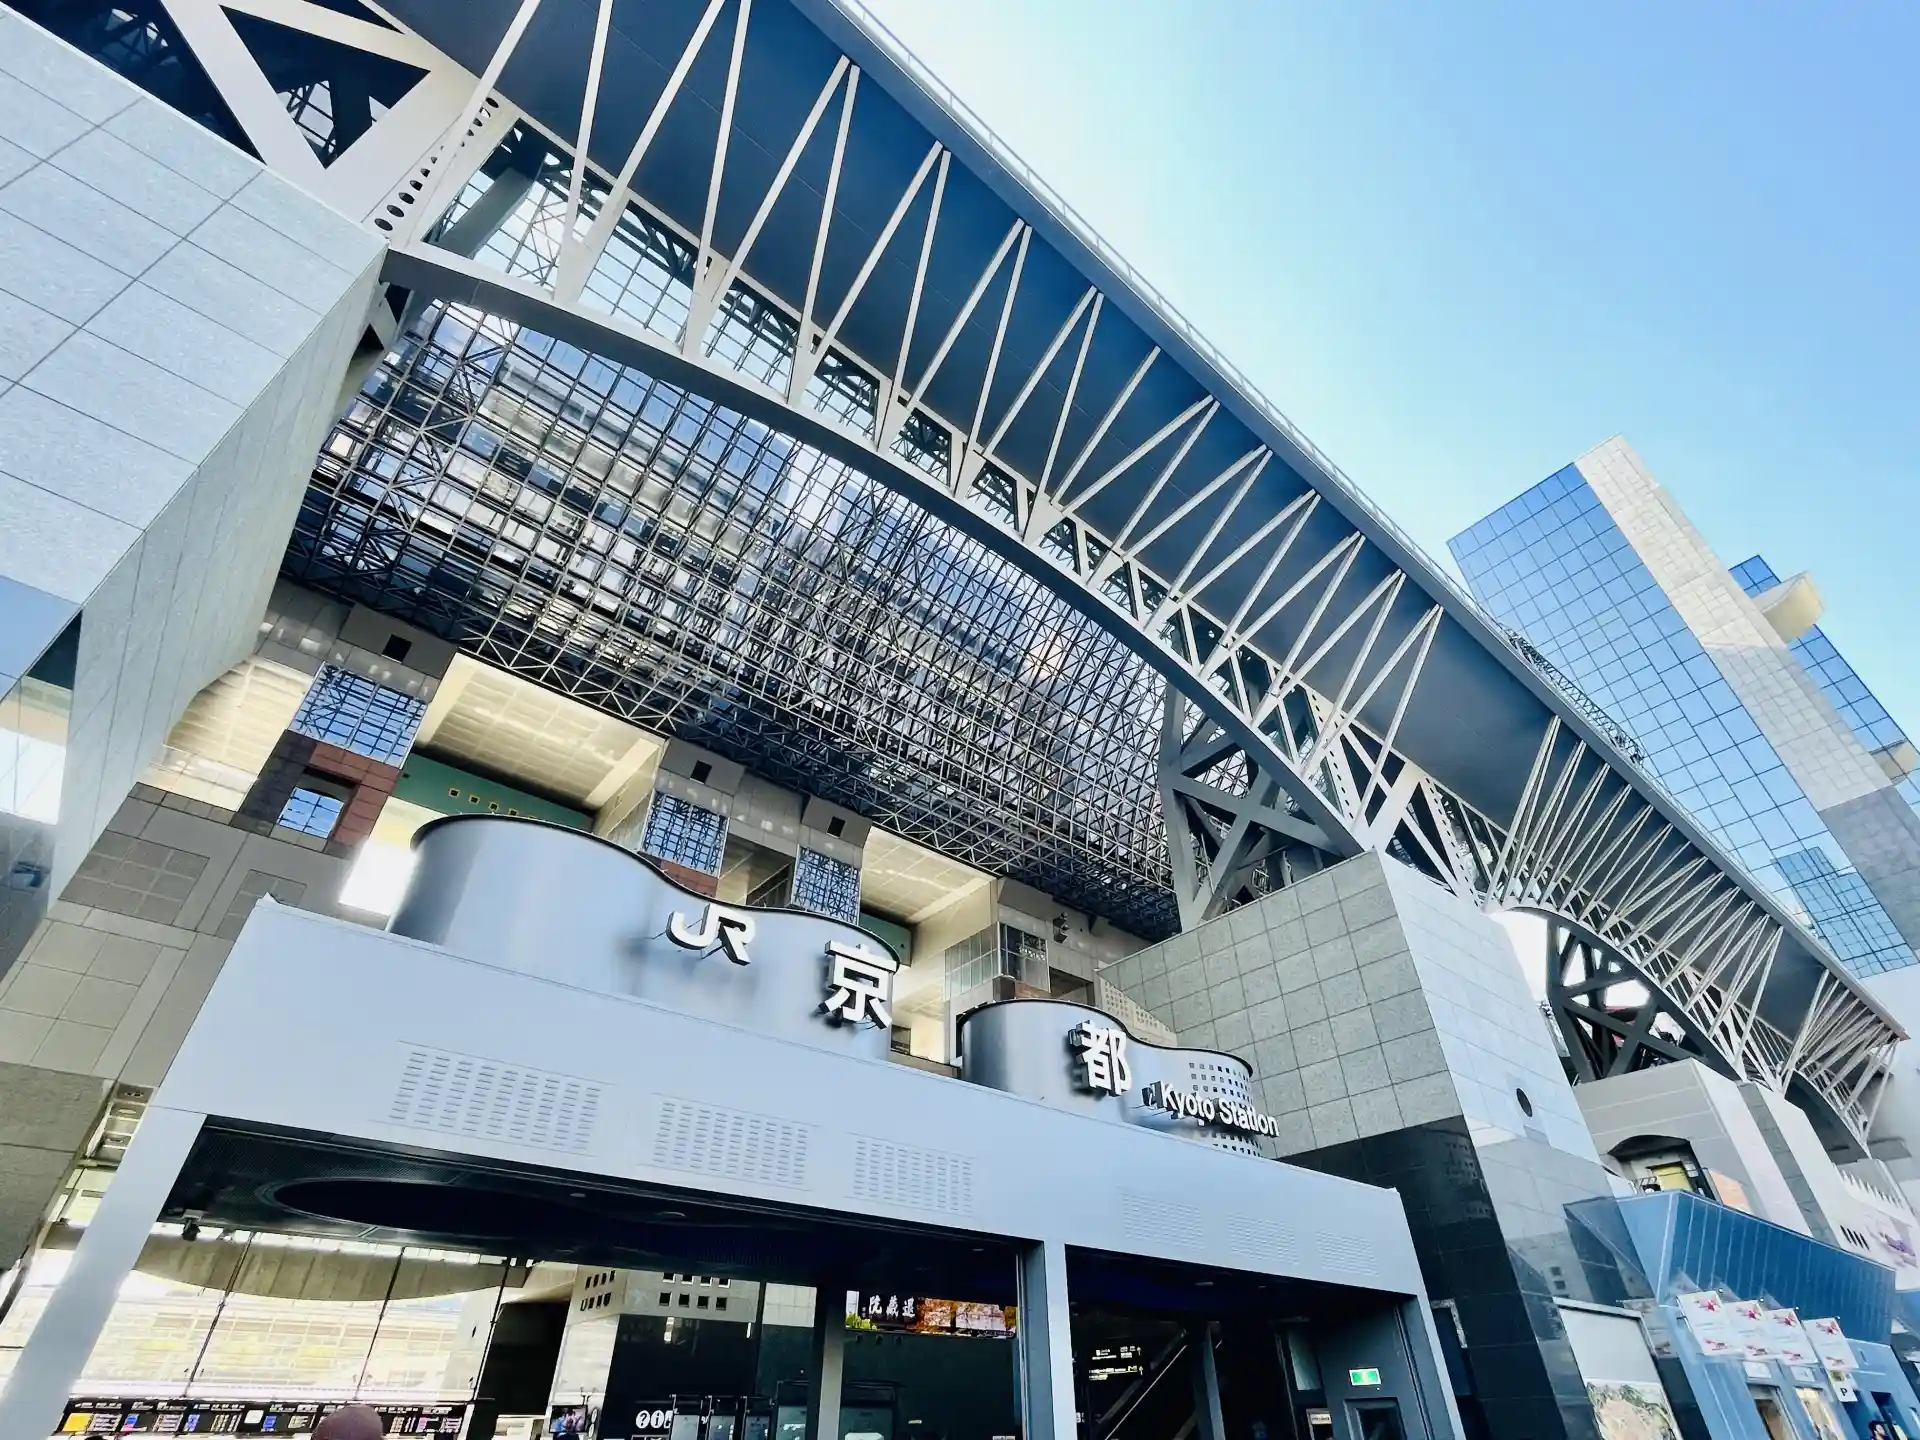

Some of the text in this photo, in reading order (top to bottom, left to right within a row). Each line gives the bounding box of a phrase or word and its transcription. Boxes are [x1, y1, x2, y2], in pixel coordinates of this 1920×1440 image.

[667, 902, 756, 966] JR
[1156, 1080, 1280, 1138] Kyoto Station
